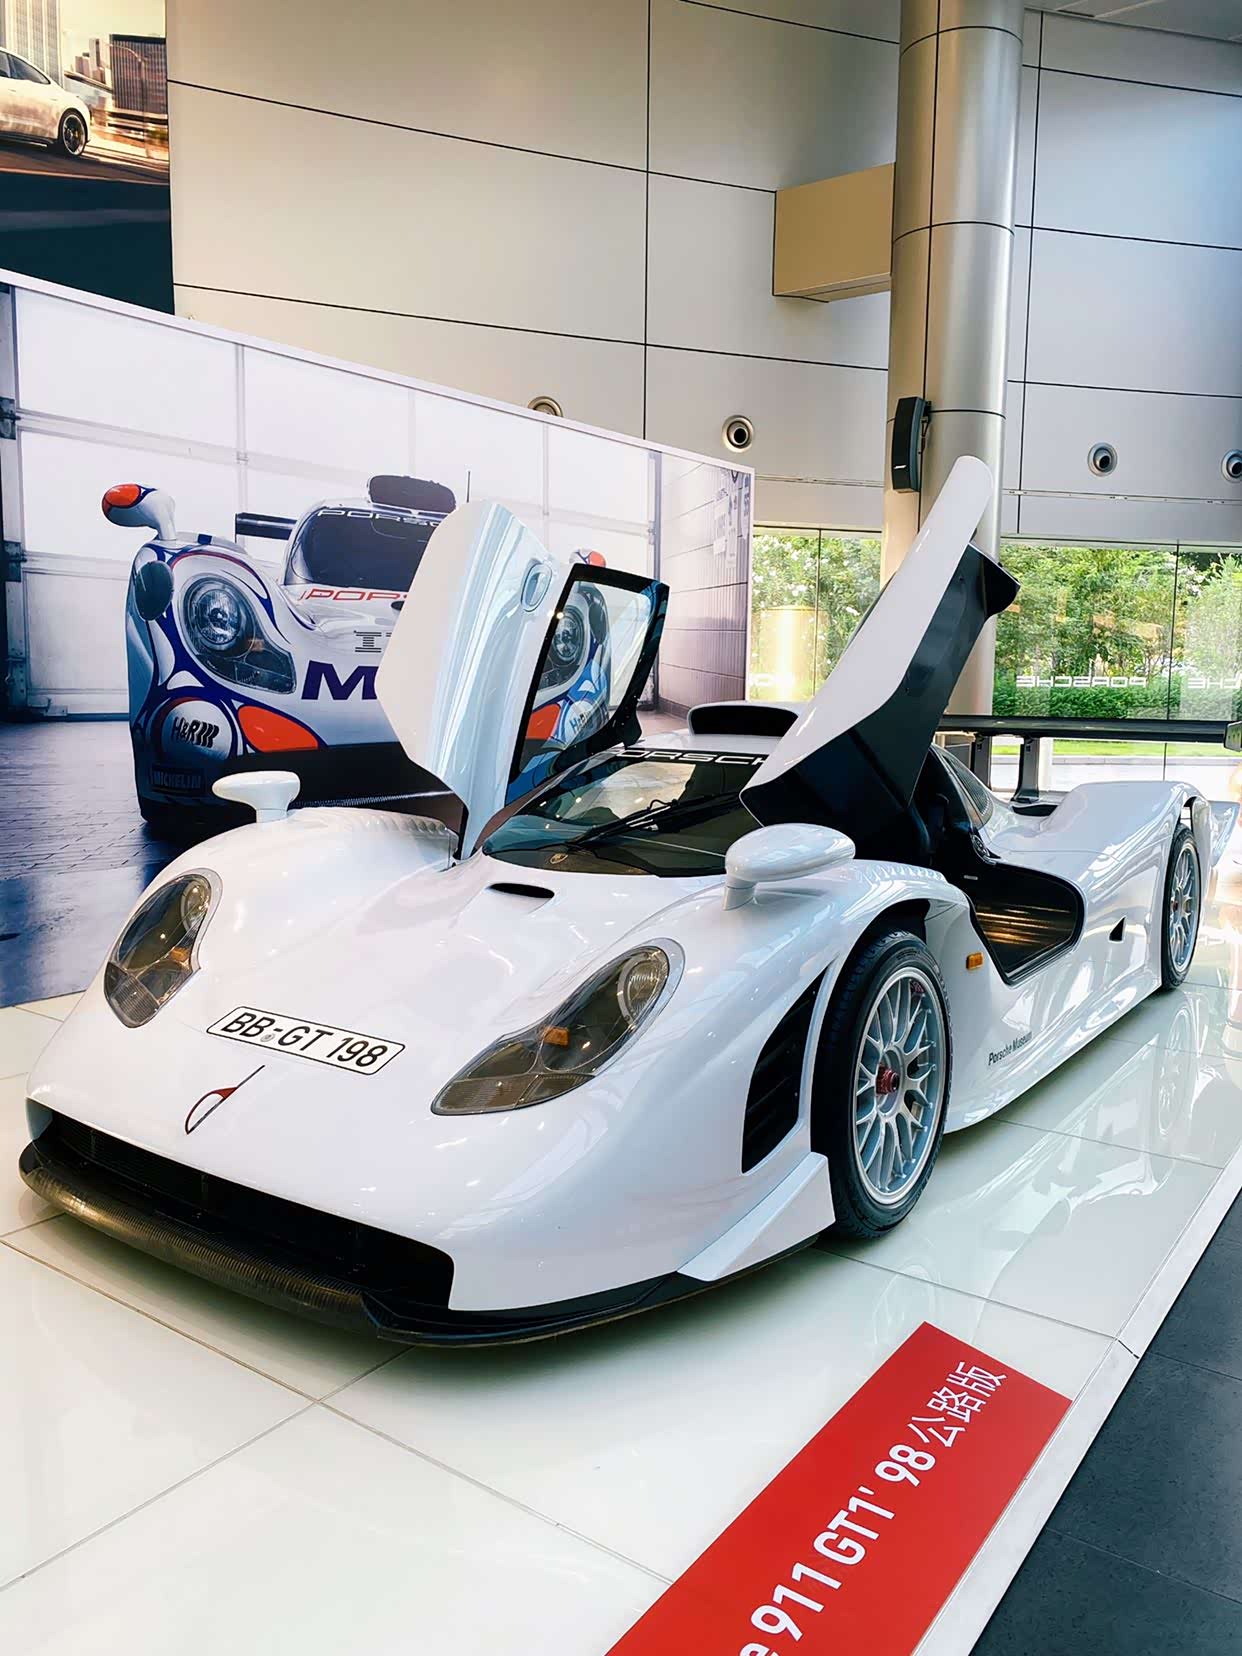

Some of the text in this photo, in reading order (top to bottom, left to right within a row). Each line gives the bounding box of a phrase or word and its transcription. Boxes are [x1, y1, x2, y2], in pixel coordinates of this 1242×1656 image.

[305, 588, 408, 601] POR
[326, 1036, 389, 1068] 198
[988, 1043, 1012, 1066] Porsche
[750, 1562, 843, 1642] 911
[874, 1444, 937, 1488] 98
[907, 1359, 1008, 1448] 公路版
